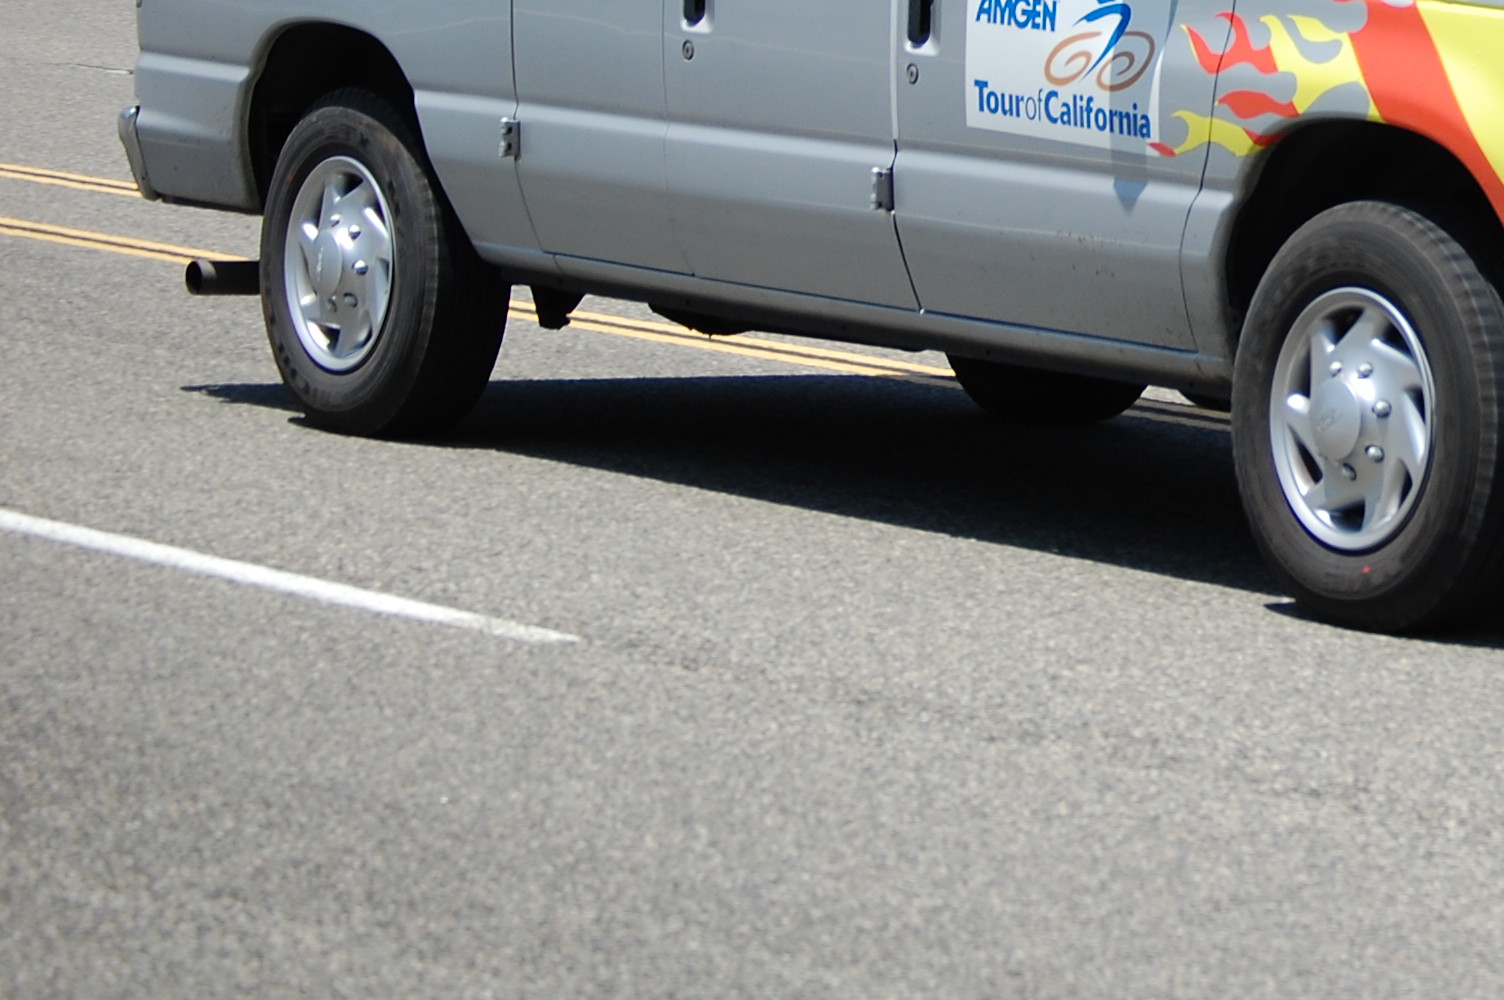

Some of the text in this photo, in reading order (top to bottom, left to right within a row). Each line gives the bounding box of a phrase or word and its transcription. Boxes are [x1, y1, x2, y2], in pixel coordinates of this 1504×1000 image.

[974, 79, 1151, 139] Tour of California
